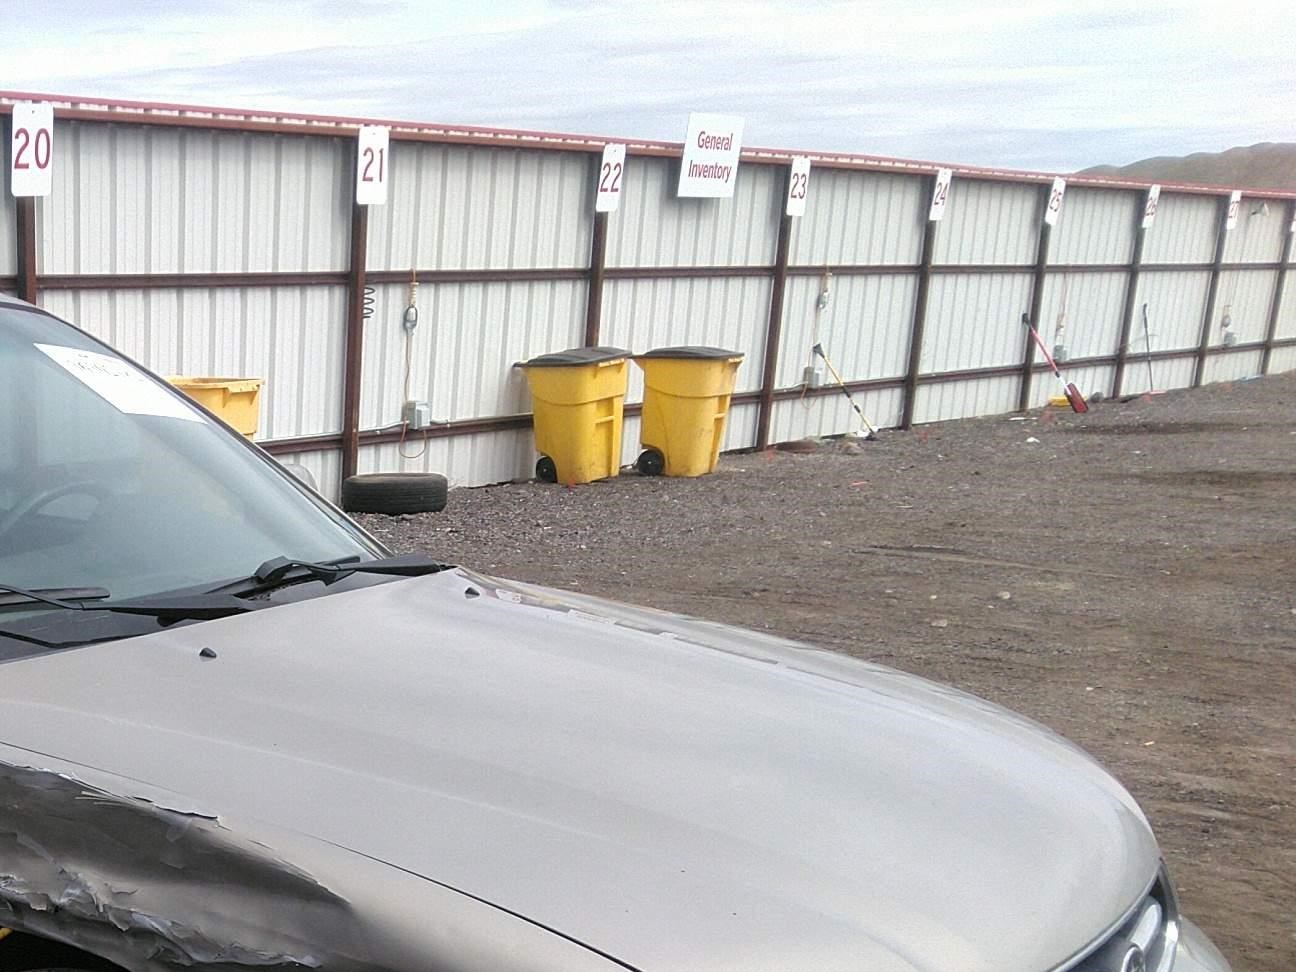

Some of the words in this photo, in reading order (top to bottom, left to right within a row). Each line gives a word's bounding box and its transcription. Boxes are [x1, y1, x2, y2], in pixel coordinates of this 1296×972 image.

[14, 127, 51, 170] 20
[697, 130, 734, 152] General
[362, 146, 384, 183] 21
[599, 162, 622, 193] 22
[687, 159, 732, 184] Inventory
[790, 172, 807, 199] 23
[933, 181, 949, 206] 24
